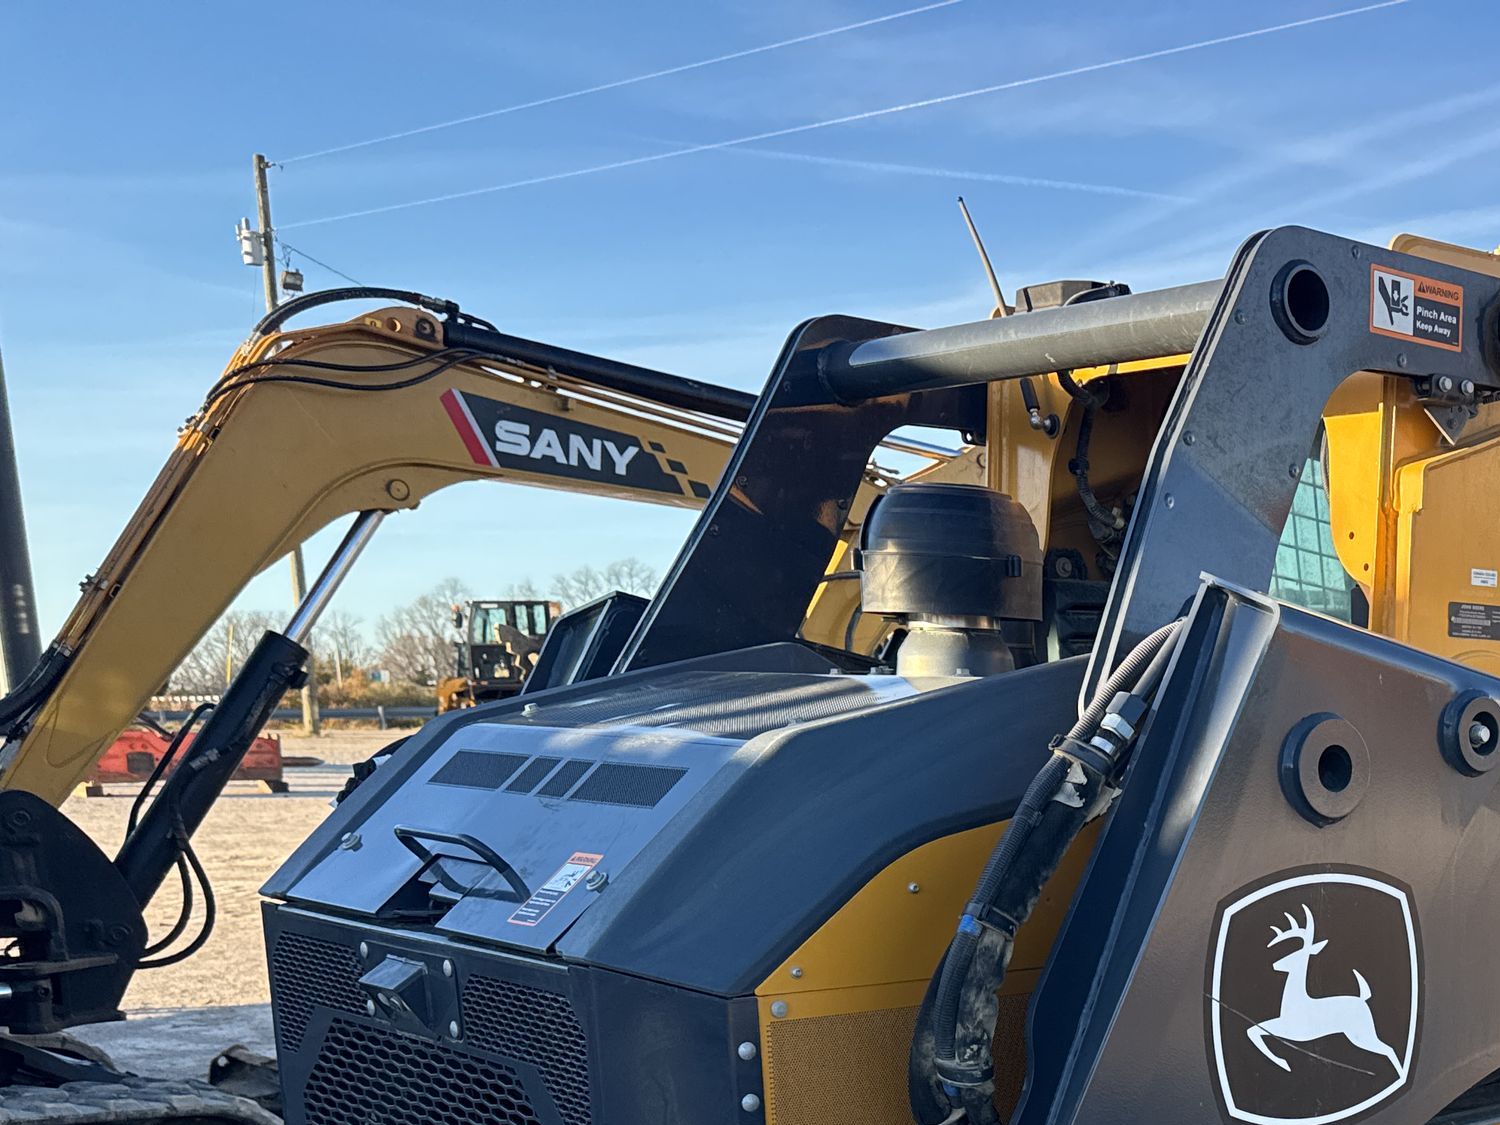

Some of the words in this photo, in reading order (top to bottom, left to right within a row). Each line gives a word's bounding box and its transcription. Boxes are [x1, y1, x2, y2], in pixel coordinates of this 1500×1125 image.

[1425, 285, 1460, 302] WARNING
[1416, 305, 1438, 320] Pinch
[1439, 311, 1457, 325] Area
[1416, 321, 1432, 334] Keep
[1433, 324, 1451, 338] Away
[494, 419, 640, 476] SANY
